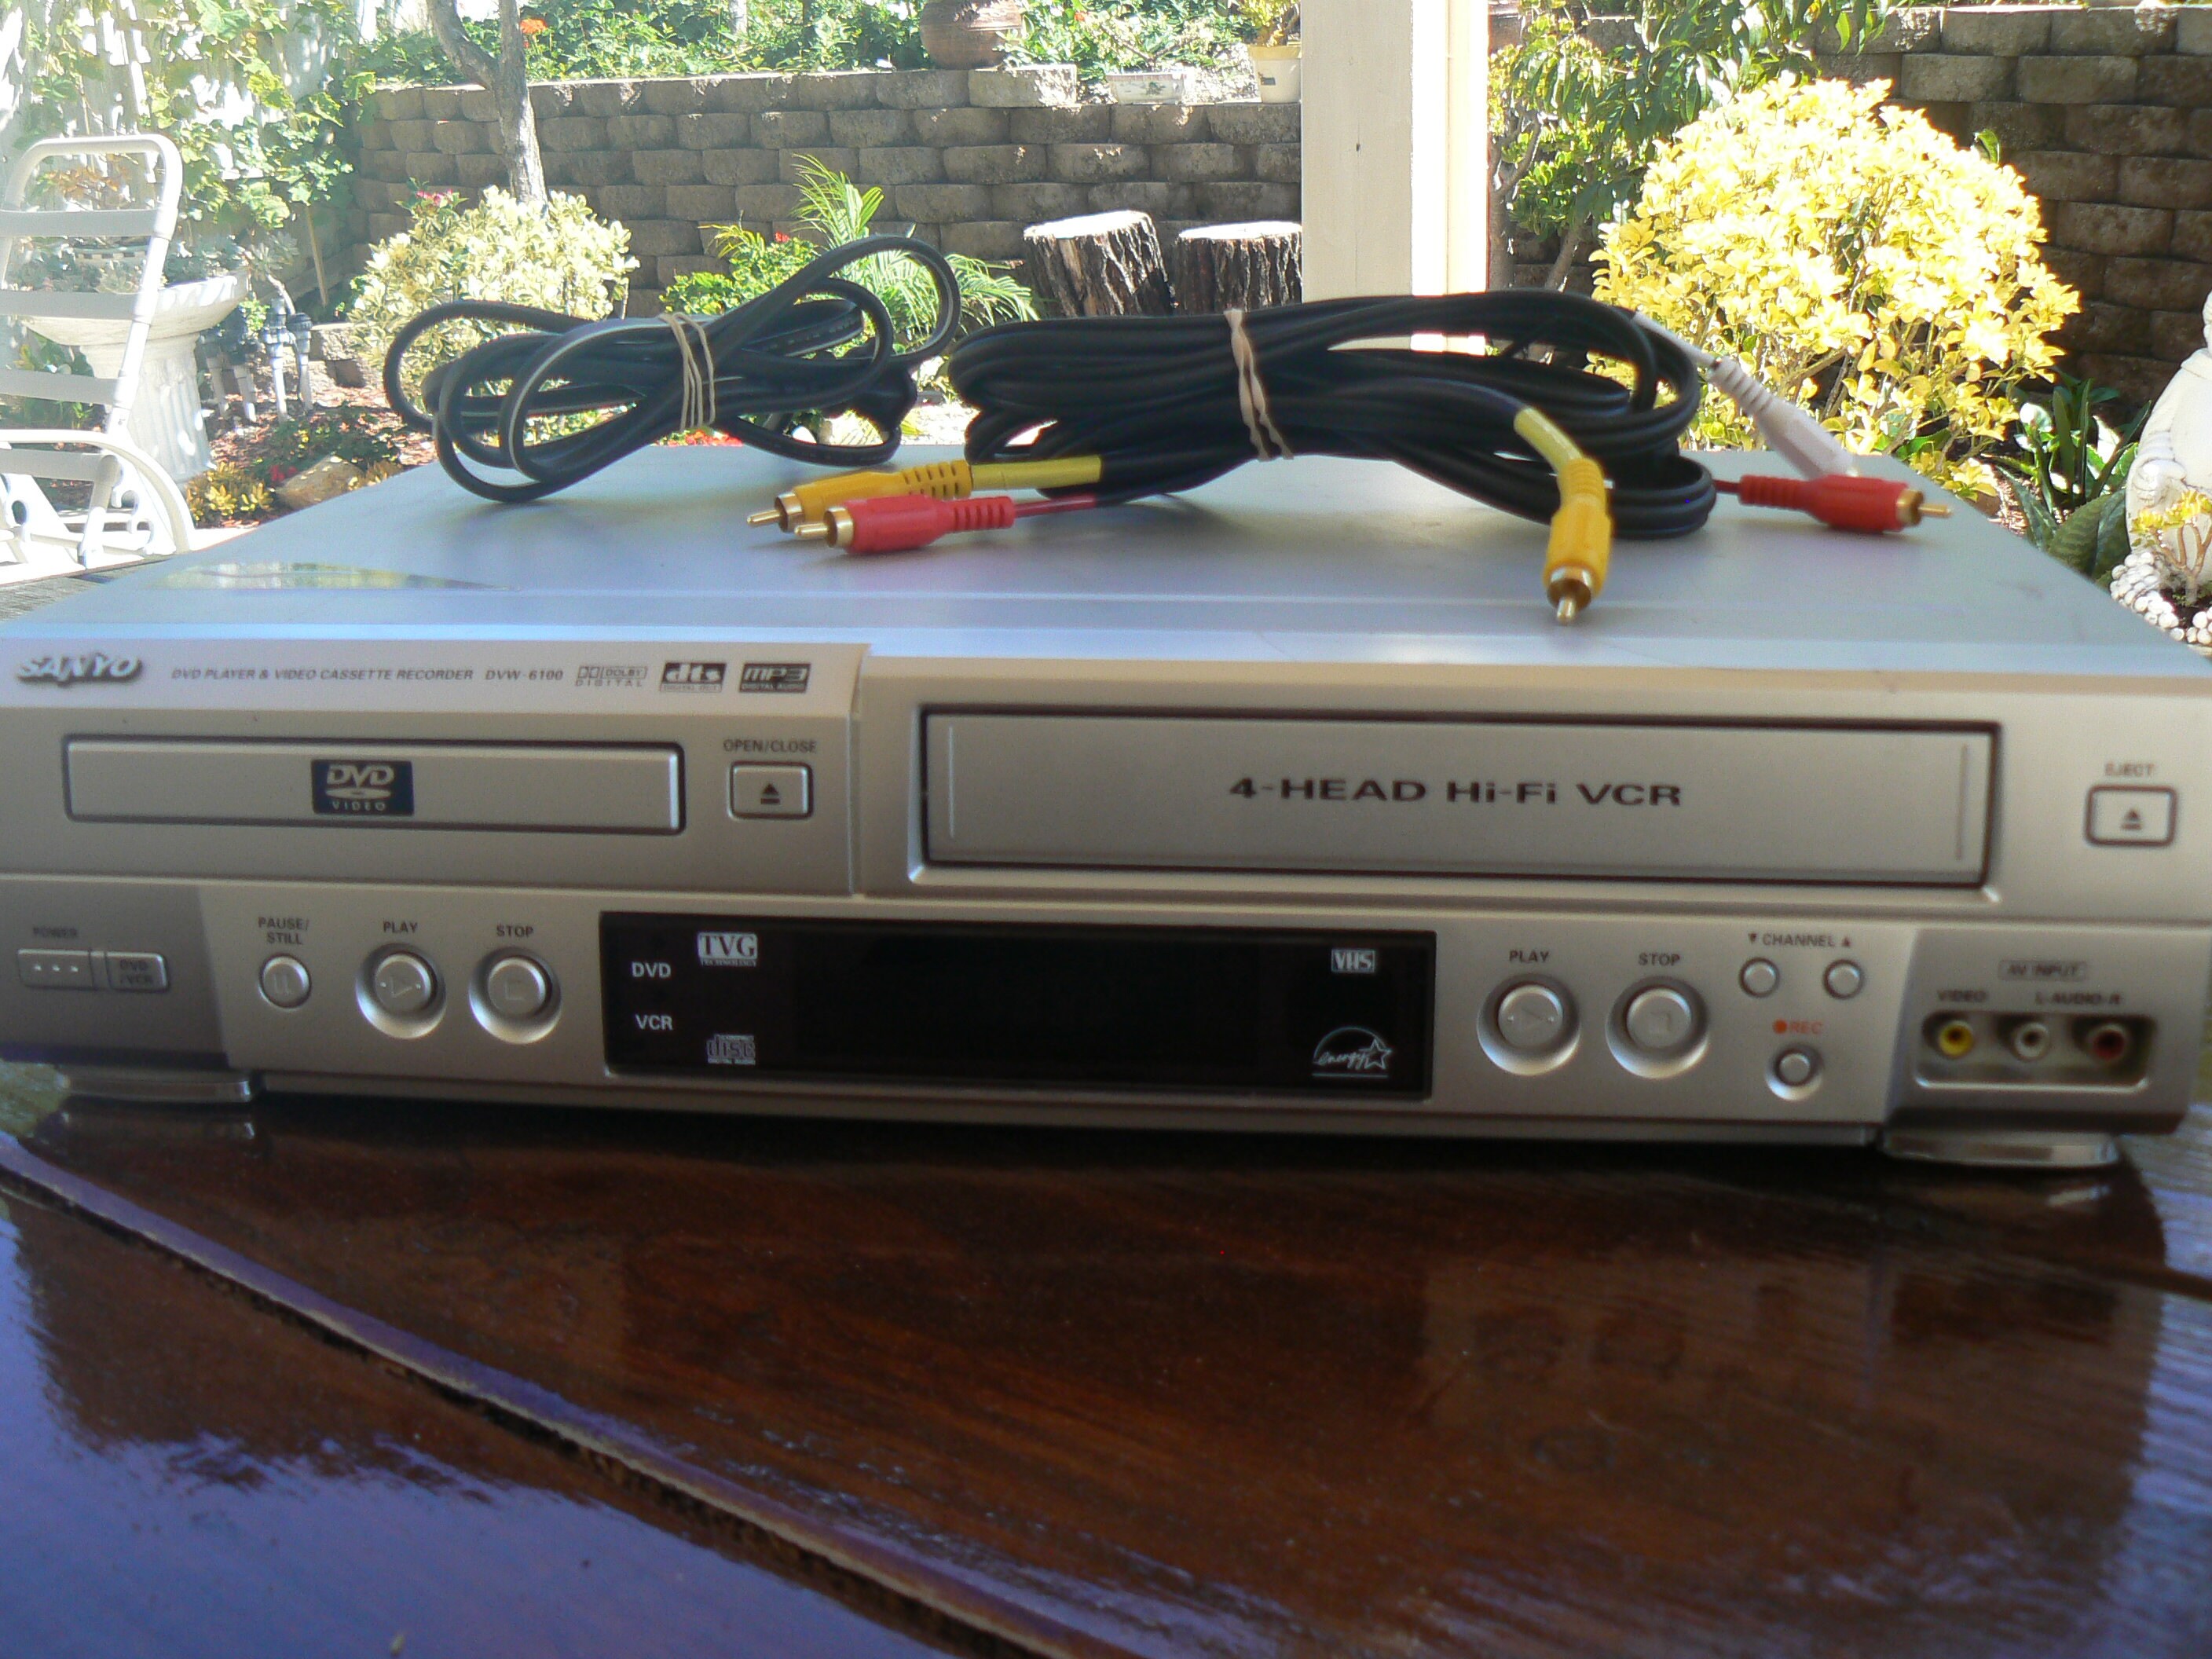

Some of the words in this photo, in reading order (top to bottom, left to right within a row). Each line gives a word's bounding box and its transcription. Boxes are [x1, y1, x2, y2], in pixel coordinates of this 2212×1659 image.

[17, 653, 143, 687] SANYO
[171, 668, 200, 680] DVD
[204, 668, 256, 680] PLAYER
[258, 669, 269, 680] &
[275, 668, 317, 680] VIDEO
[320, 669, 392, 680] CASSETTE
[396, 668, 474, 680] RECORDER
[485, 668, 564, 681] DVW-6100
[665, 664, 723, 683] dts
[723, 738, 817, 753] OPEN/CLOSE
[326, 764, 394, 786] DVD
[2105, 763, 2155, 777] EJECT
[1229, 778, 1427, 803] 4-HEAD
[1446, 781, 1557, 804] Hi-Fi
[1577, 783, 1682, 806] VCR
[331, 800, 386, 811] VIDEO
[258, 917, 309, 930] PAUSE/
[383, 921, 419, 934] PLAY
[496, 924, 535, 938] STOP
[266, 932, 302, 945] STILL
[1762, 932, 1836, 947] CHANNEL
[1335, 951, 1372, 970] VHS
[1509, 950, 1550, 965] PLAY
[1638, 953, 1681, 968] STOP
[632, 961, 671, 978] DVD
[1937, 989, 1987, 1003] VIDEO
[635, 1014, 674, 1031] VCR
[1789, 1020, 1823, 1035] REC
